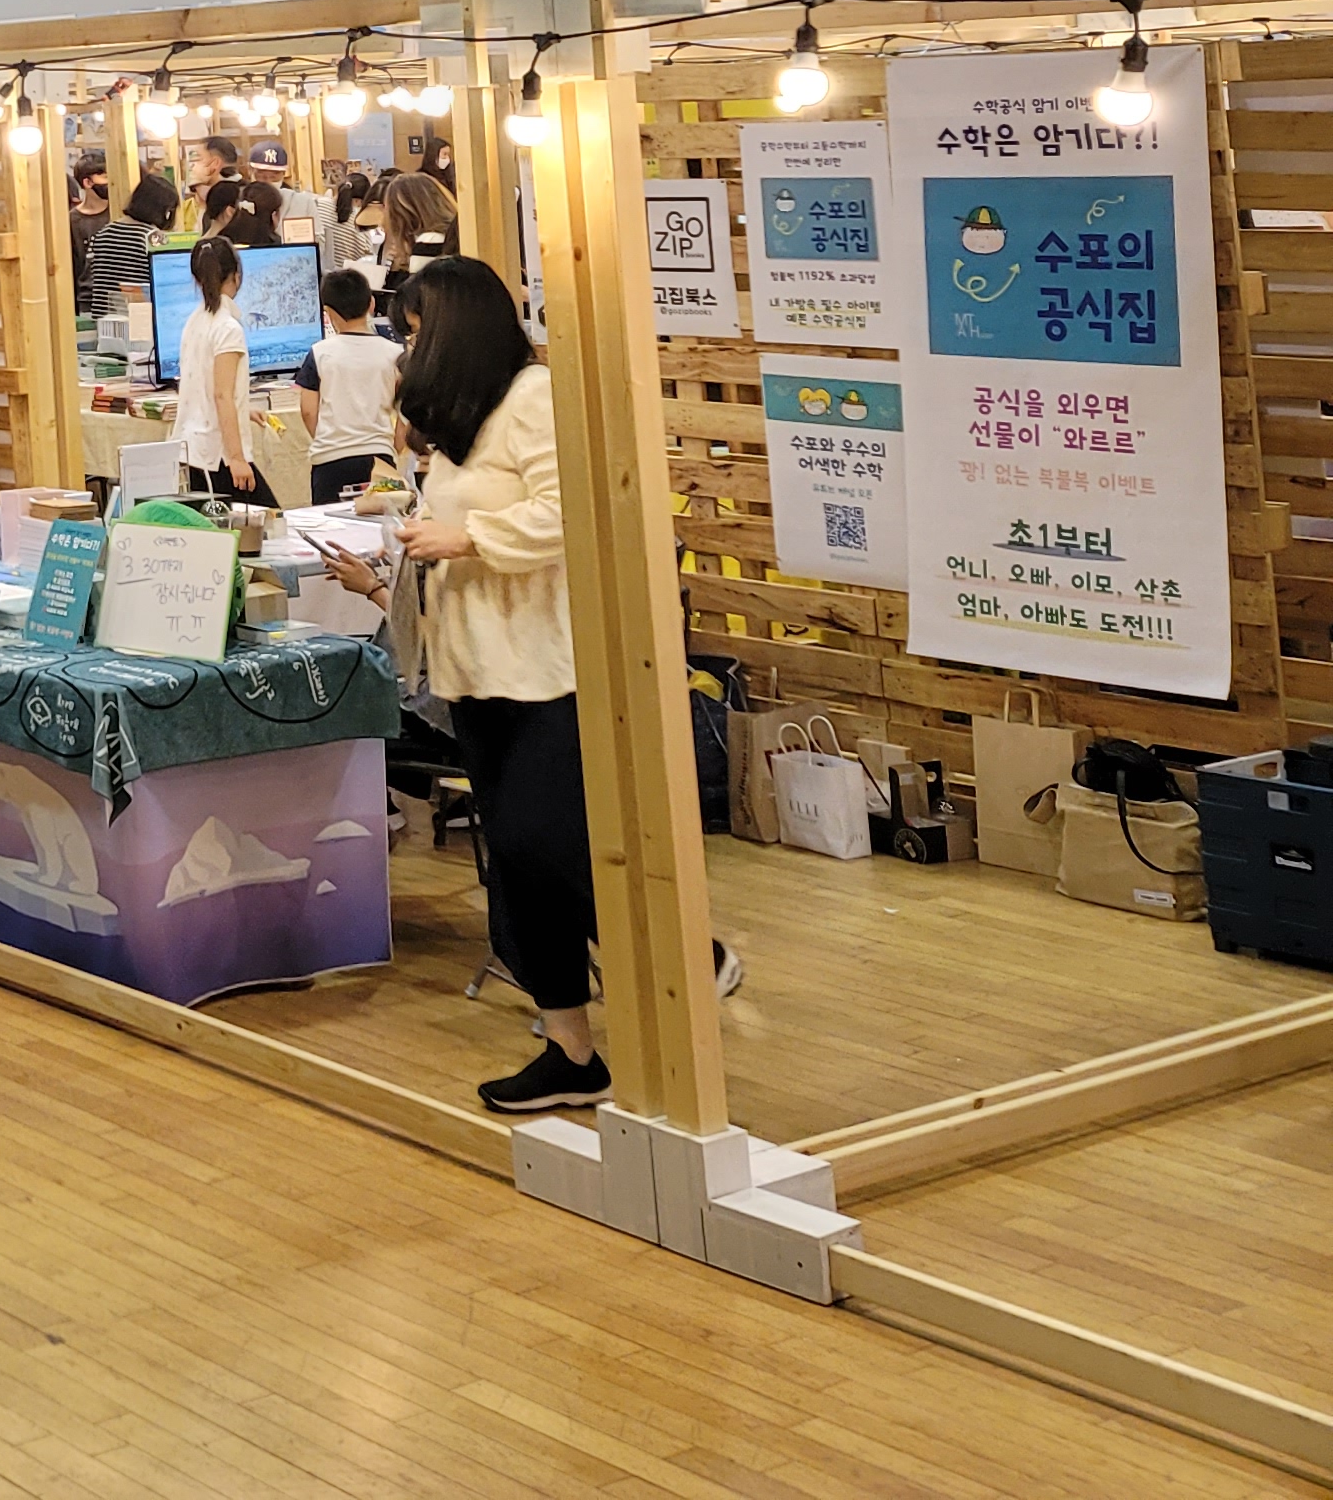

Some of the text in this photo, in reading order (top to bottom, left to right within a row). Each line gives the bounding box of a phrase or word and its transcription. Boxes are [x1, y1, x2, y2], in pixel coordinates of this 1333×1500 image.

[972, 98, 1027, 115] 수학공식
[1032, 97, 1059, 113] 암기
[937, 122, 1159, 157] 수학은 암기다?!
[809, 199, 866, 220] 수포의
[654, 231, 693, 258] ZIP
[811, 227, 870, 253] 공식집
[1035, 230, 1154, 274] 수포의
[798, 270, 836, 281] 1192%
[653, 286, 718, 306] 고집북스
[821, 299, 842, 311] 필수
[847, 301, 882, 314] 아이템
[813, 314, 866, 328] 수학공식집
[1037, 286, 1157, 344] 공식집
[973, 386, 1130, 425] 공식을 외우면
[790, 435, 886, 458] 수포와 우수의
[968, 420, 1040, 450] 선물이
[799, 456, 884, 482] 어색한 수학
[995, 464, 1030, 487] 없는
[1038, 468, 1090, 492] 복불복
[1098, 473, 1157, 497] 이벤트
[1007, 518, 1113, 558] 초1부터
[1008, 563, 1060, 590] 오빠,
[1071, 571, 1123, 598] 이모,
[1134, 578, 1182, 604] 삼촌
[957, 592, 1175, 642] 엄마, 아빠도 도전!!!
